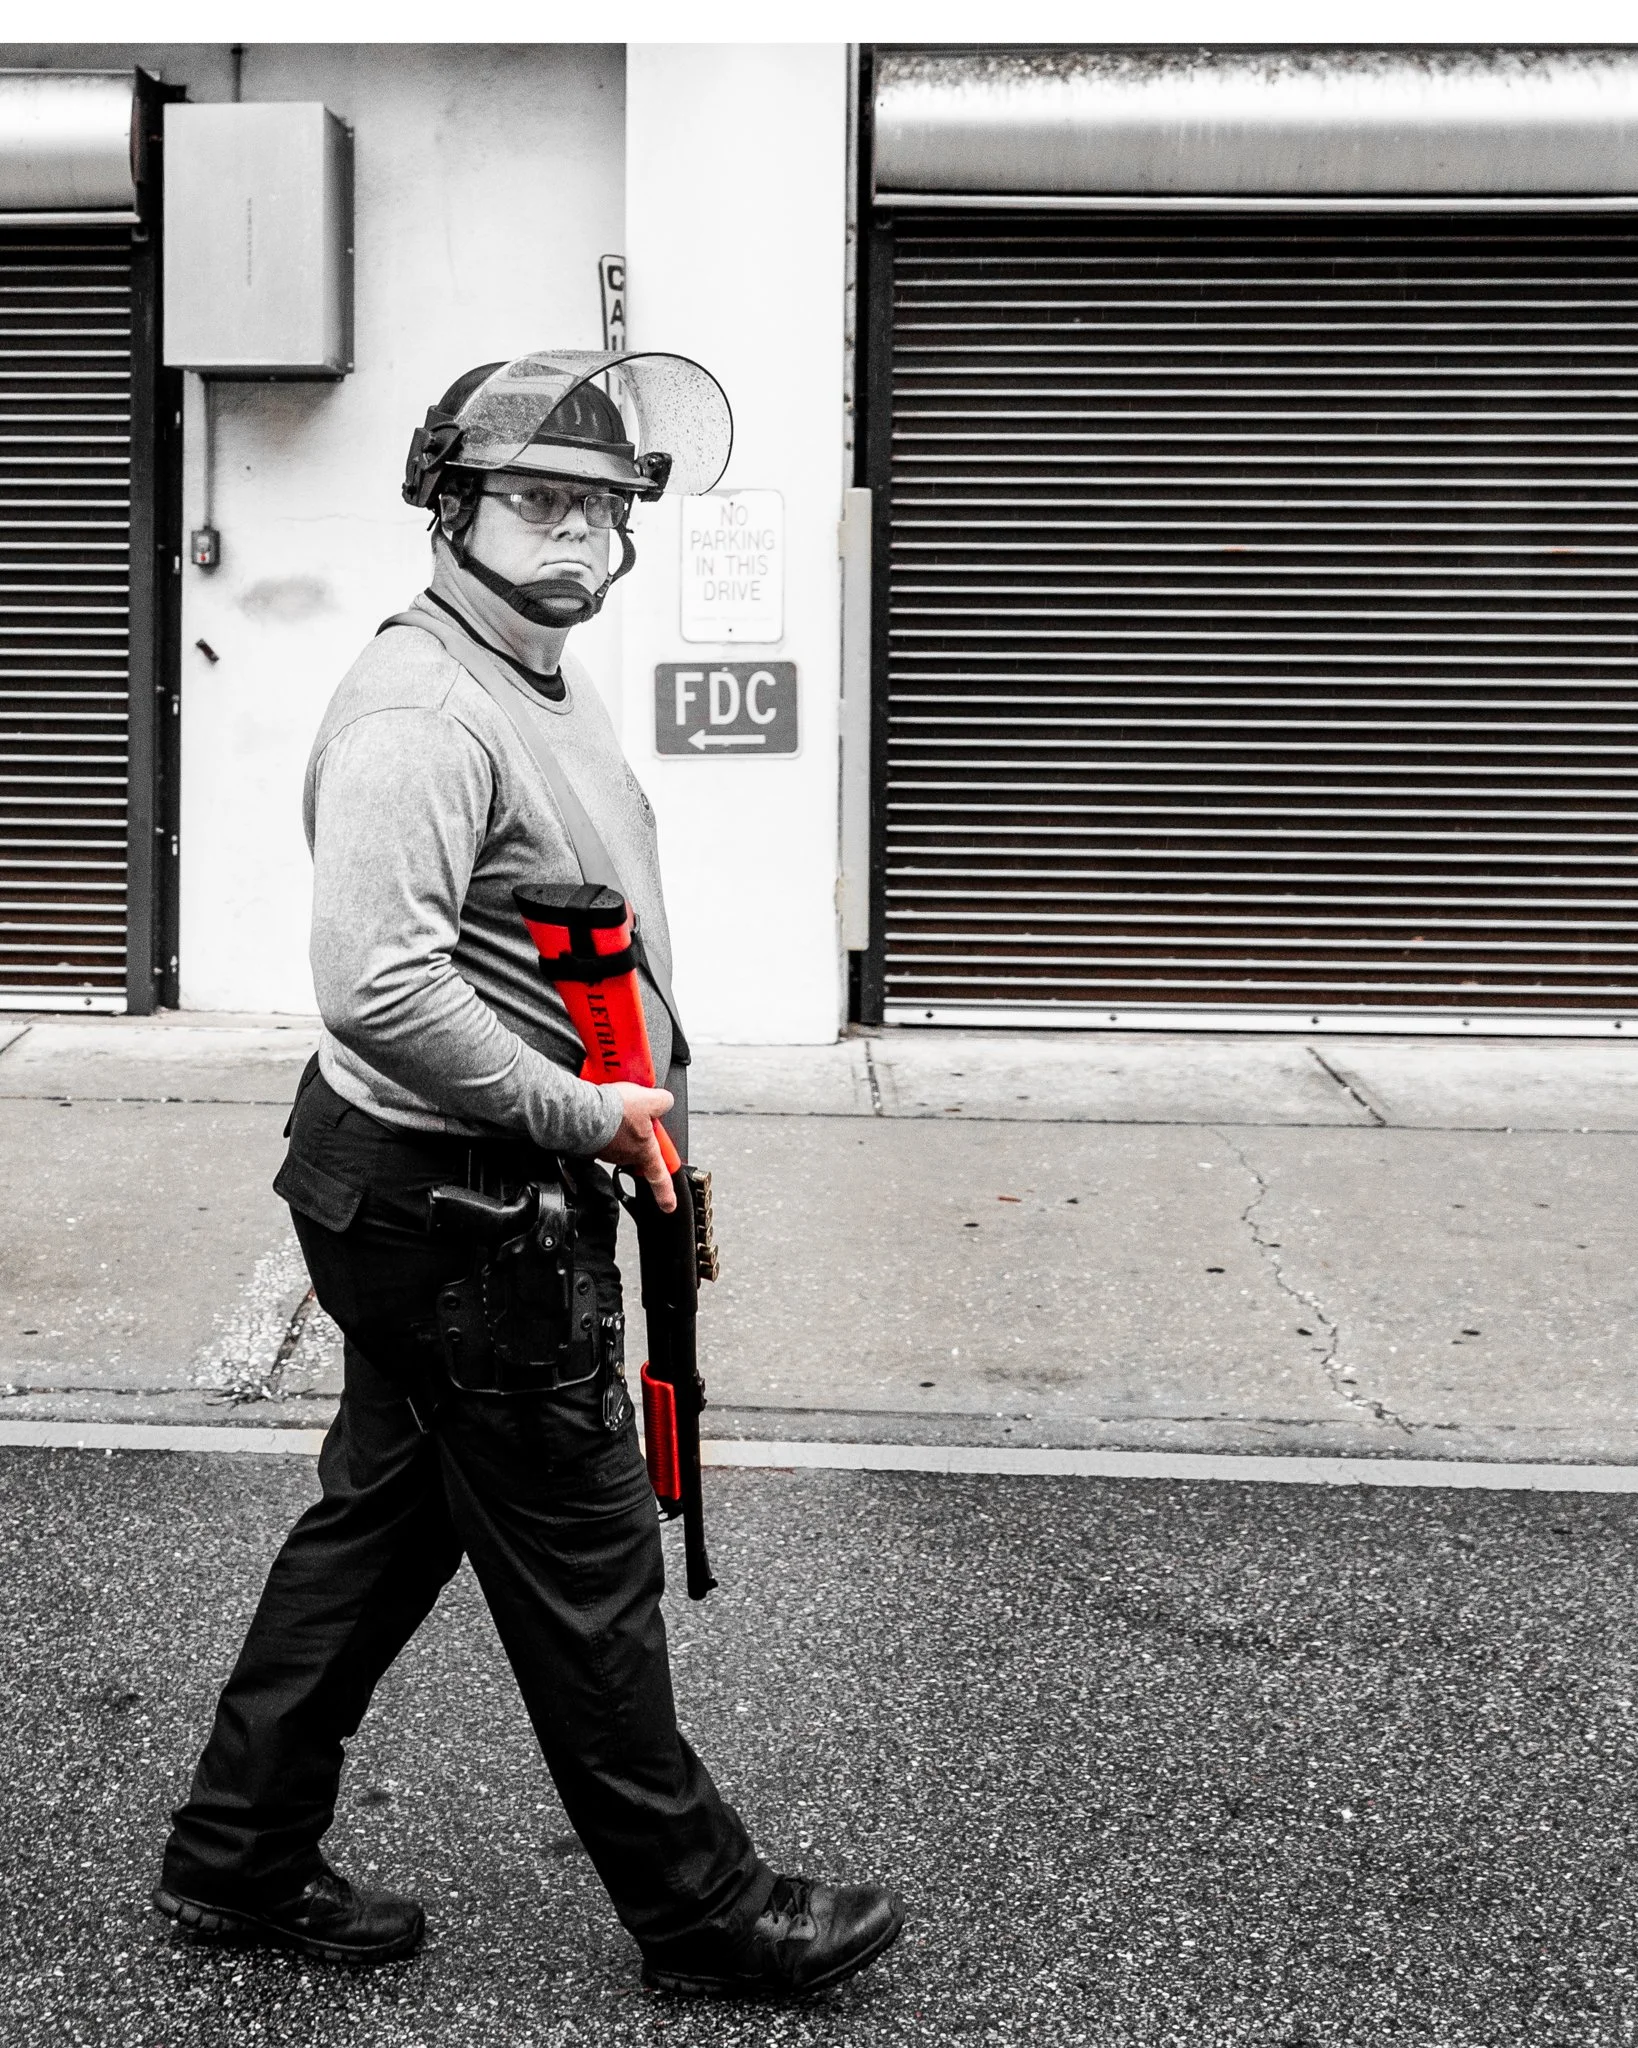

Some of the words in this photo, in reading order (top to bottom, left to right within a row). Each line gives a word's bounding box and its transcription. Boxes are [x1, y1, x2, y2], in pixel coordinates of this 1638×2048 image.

[720, 506, 747, 528] NO
[690, 529, 776, 551] PARKING
[696, 556, 714, 577] IN
[725, 555, 769, 577] THIS
[703, 580, 762, 603] DRIVE
[675, 669, 777, 727] FDC
[587, 994, 621, 1073] LETHAL
